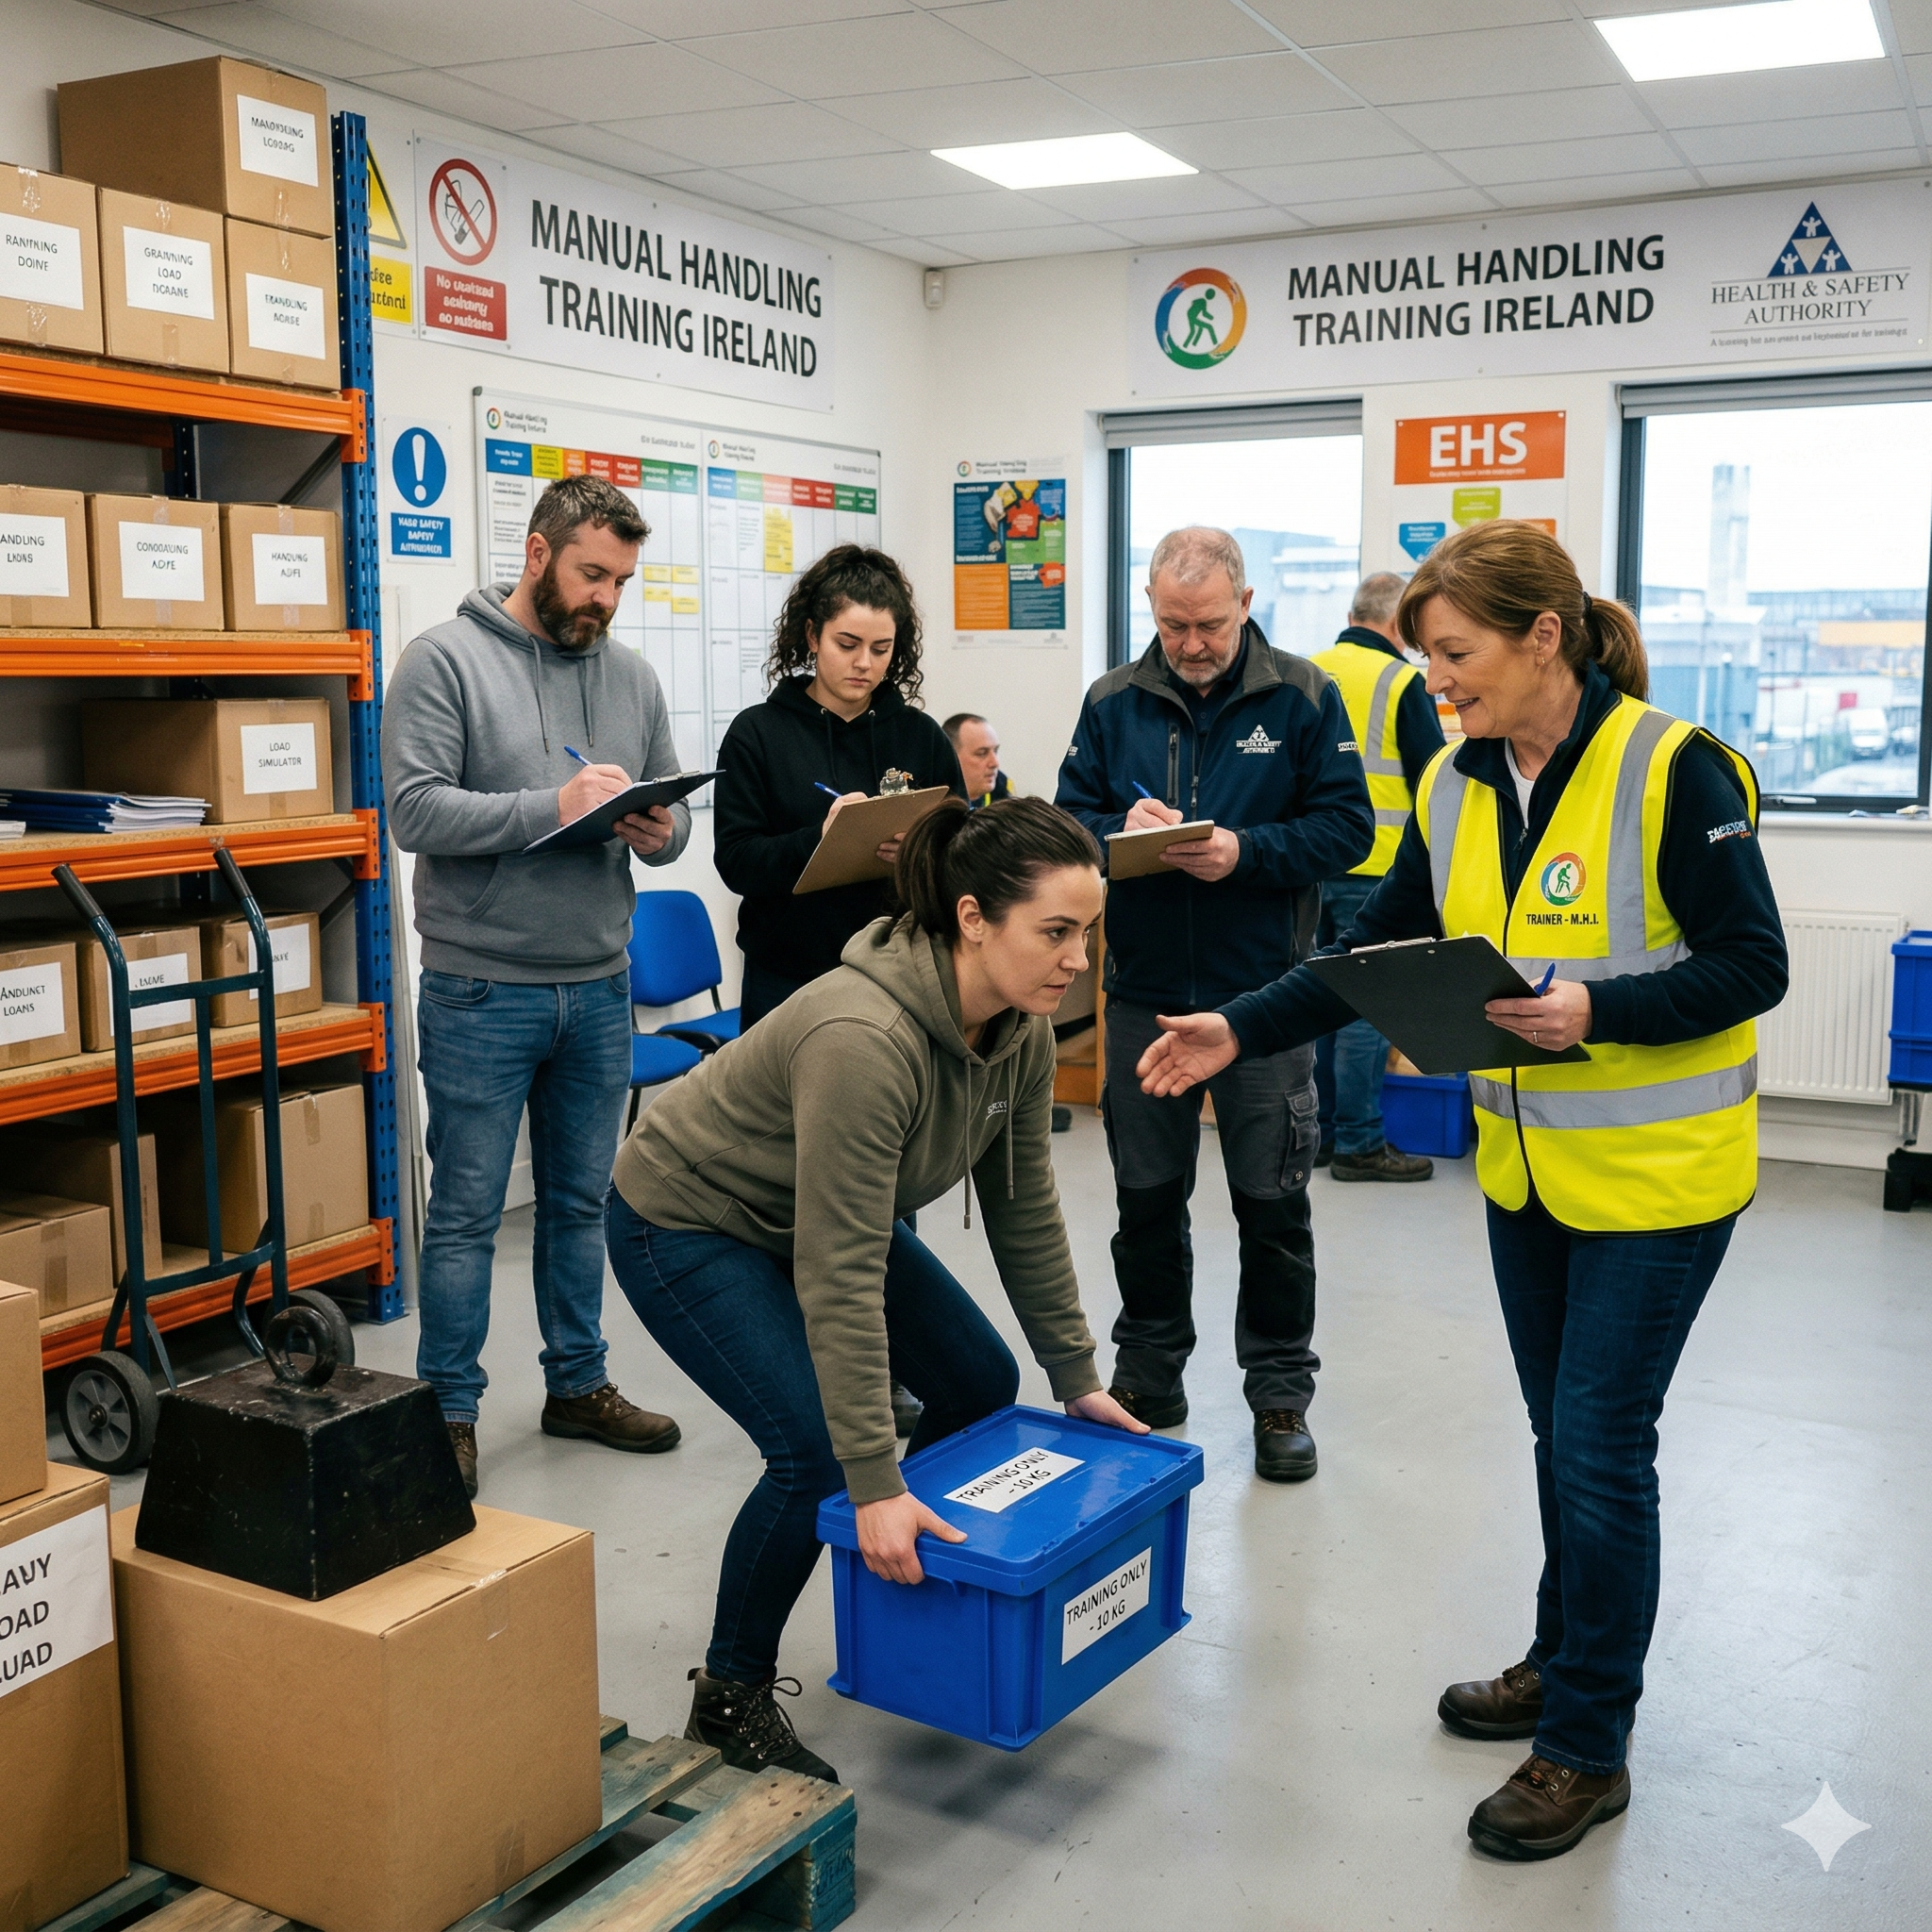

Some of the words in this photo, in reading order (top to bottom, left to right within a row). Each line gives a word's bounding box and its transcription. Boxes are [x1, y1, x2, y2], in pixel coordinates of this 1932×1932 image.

[531, 199, 672, 281] MANUAL
[680, 240, 822, 318] HANDLING
[1288, 255, 1444, 301] MANUAL
[1457, 234, 1665, 287] HANDLING
[436, 274, 452, 290] No
[1711, 281, 1795, 304] HEALTH
[1802, 280, 1819, 298] &
[1824, 273, 1910, 296] SAFETY
[540, 275, 693, 354] TRAINING
[703, 313, 817, 377] IRELAND
[1292, 301, 1471, 347] TRAINING
[1484, 287, 1654, 334] IRELAND
[1744, 299, 1872, 325] AUTHORITY
[1430, 421, 1527, 468] EHS
[1526, 913, 1562, 924] TRAINER
[1571, 913, 1599, 924] M.H.I.
[4, 1003, 35, 1016] LOANS
[957, 1468, 1020, 1501] TRAINING
[1014, 1451, 1049, 1470] ONLY
[1013, 1478, 1034, 1490] 10
[1026, 1470, 1052, 1481] KG
[0, 1553, 52, 1596] AVY
[1067, 1579, 1118, 1624] TRAINING
[1121, 1559, 1147, 1589] ONLY
[1097, 1609, 1109, 1630] 10
[1111, 1599, 1125, 1621] KG
[0, 1641, 53, 1684] UAD
